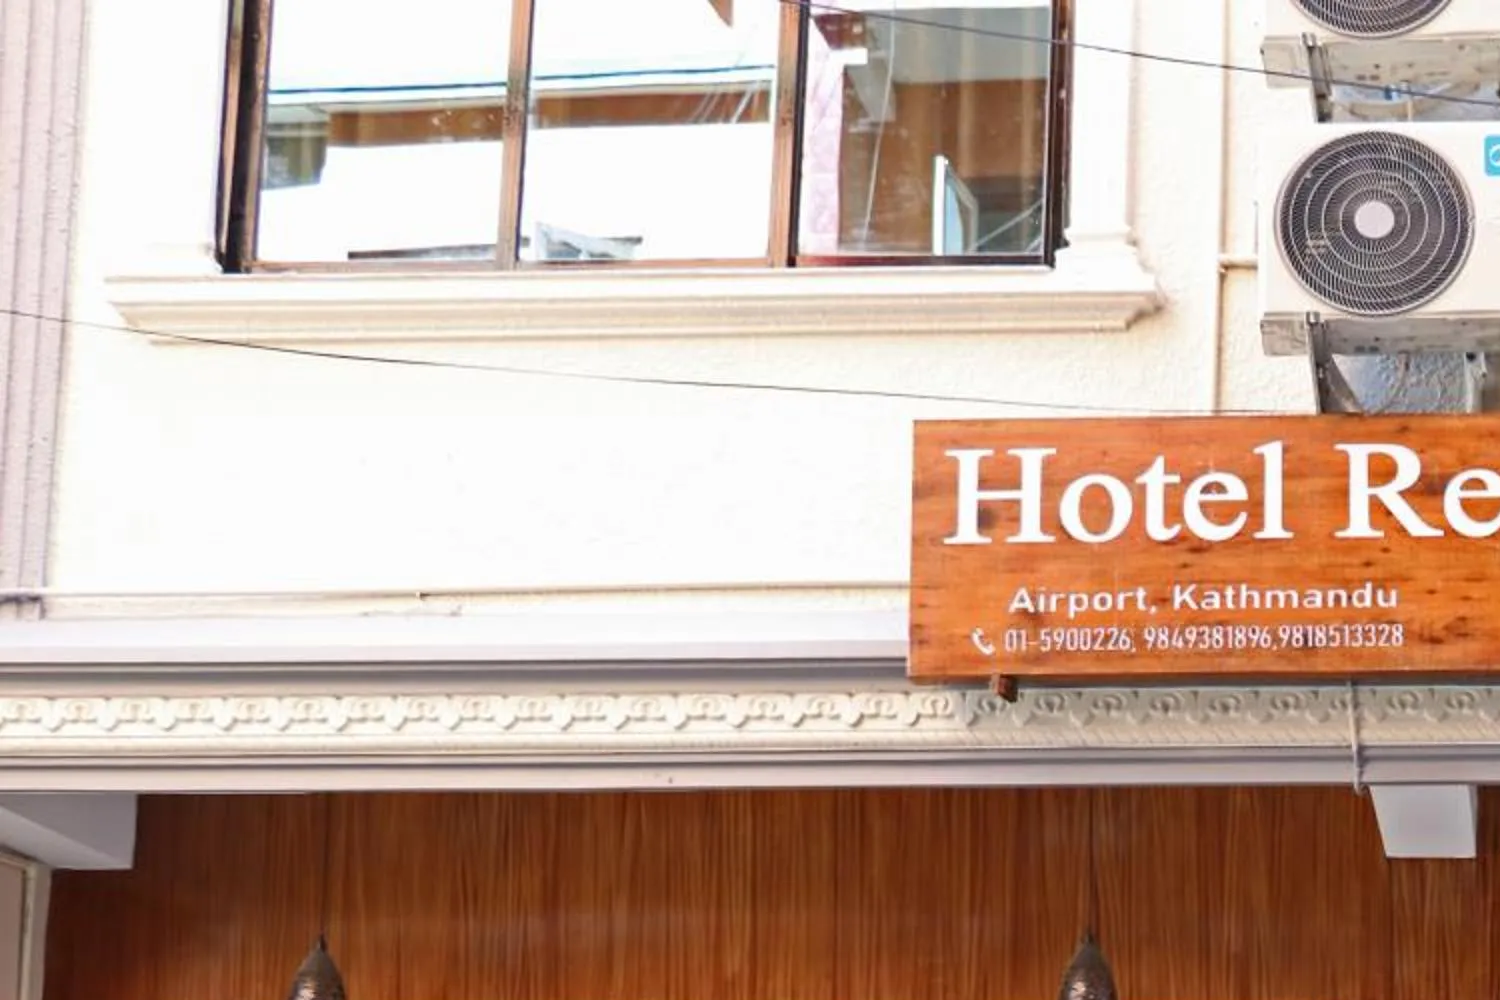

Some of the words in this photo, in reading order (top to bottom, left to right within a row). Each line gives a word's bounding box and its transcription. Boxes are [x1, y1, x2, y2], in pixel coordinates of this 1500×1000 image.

[943, 440, 1294, 545] Hotel
[1008, 586, 1158, 618] Airport,
[1172, 582, 1398, 610] Kathmandu
[1004, 626, 1136, 653] 01-5900226,
